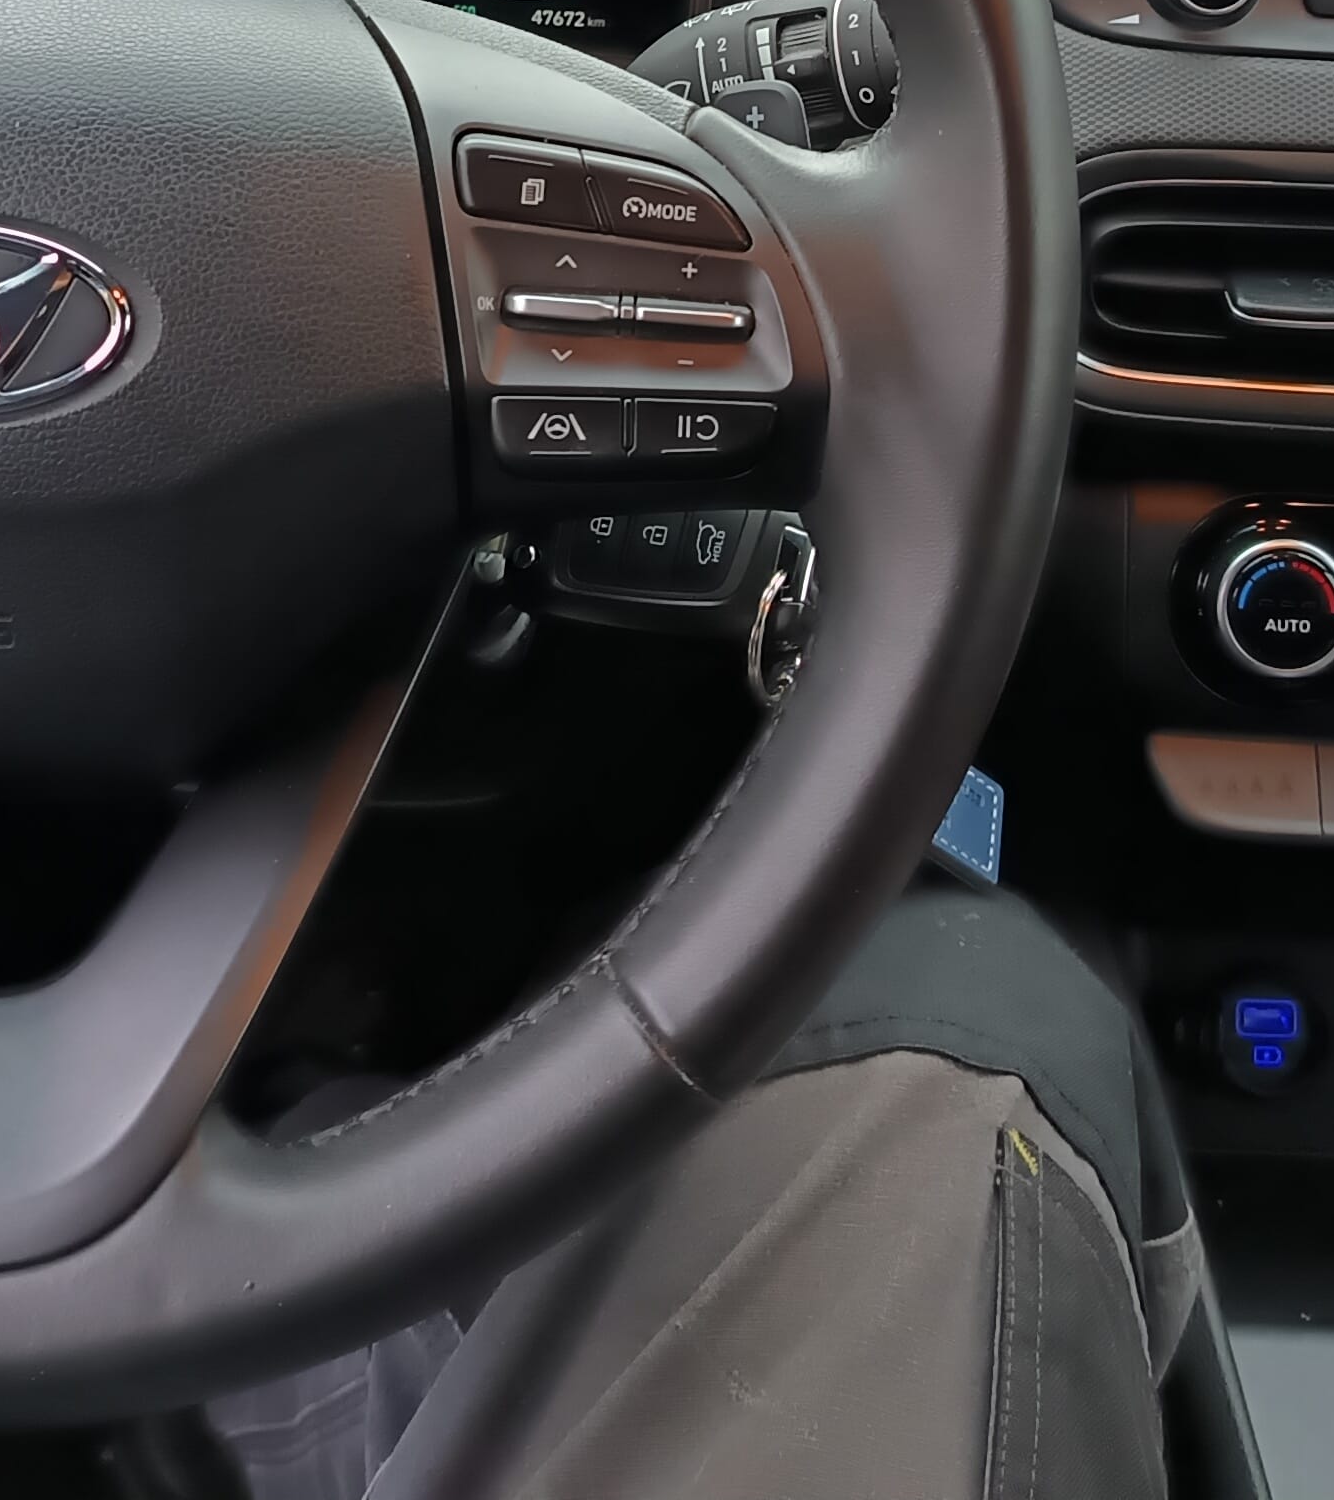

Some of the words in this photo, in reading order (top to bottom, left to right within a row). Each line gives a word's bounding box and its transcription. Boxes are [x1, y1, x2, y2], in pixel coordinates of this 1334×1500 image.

[531, 9, 586, 27] 47672
[587, 16, 606, 28] km
[847, 13, 859, 29] 2
[717, 37, 727, 53] 2
[719, 58, 728, 73] 1
[851, 50, 861, 66] 1
[711, 74, 745, 94] AUTO
[647, 203, 698, 223] MODE
[476, 295, 496, 312] OK
[711, 530, 725, 563] HOLD
[1263, 617, 1312, 635] AUTO
